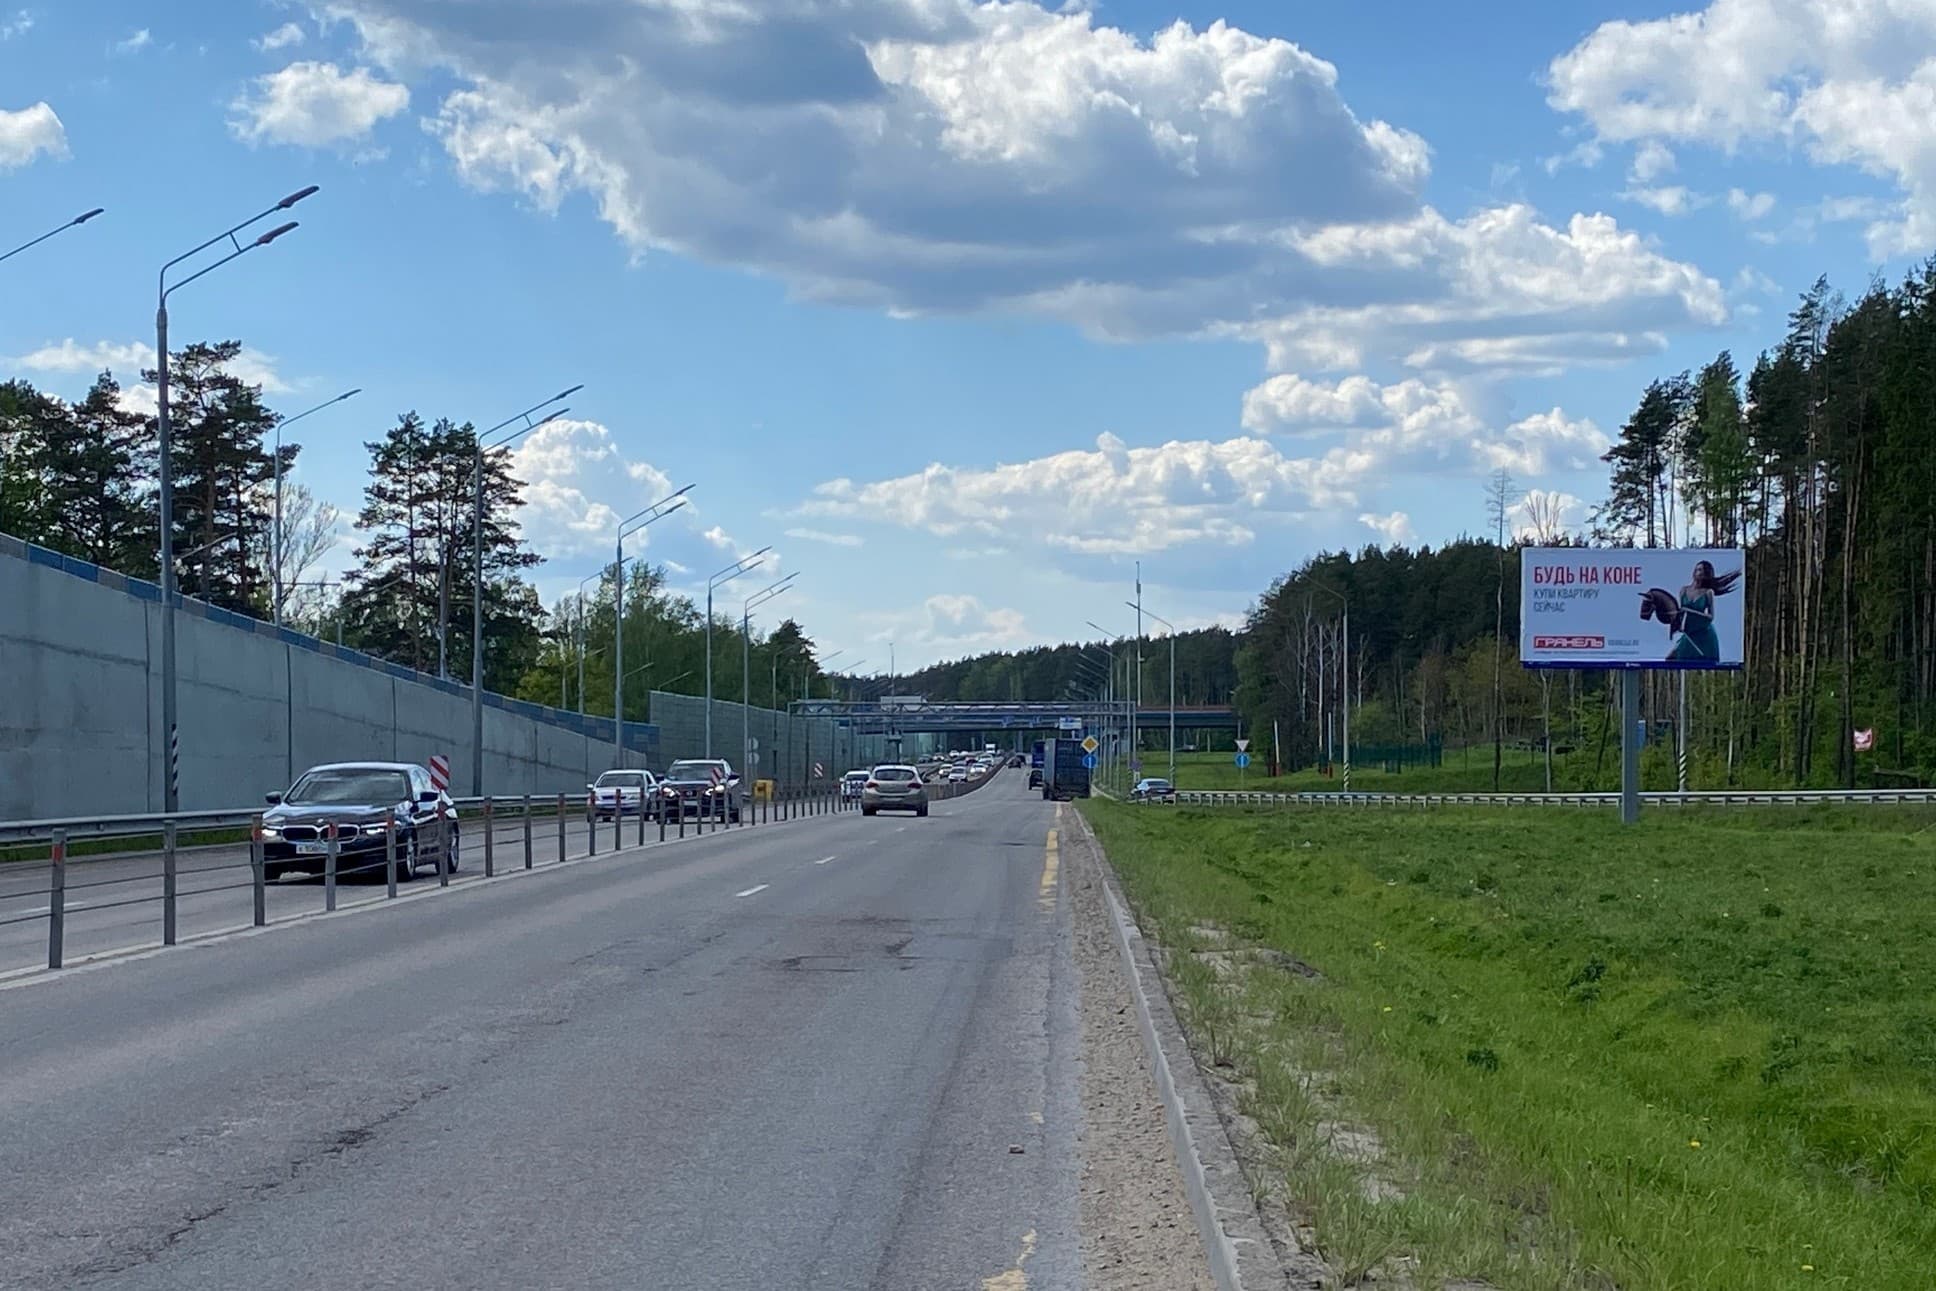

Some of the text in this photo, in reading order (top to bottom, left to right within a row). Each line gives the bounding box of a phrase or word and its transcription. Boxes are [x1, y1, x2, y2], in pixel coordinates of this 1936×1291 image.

[1534, 566, 1642, 585] БУДЬ НА КОНЕ
[1534, 588, 1600, 599] КУПИ КВАРТИРУ
[1534, 600, 1565, 612] СЕЙЧАС
[1535, 637, 1604, 648] ГРАНЕЛЬ
